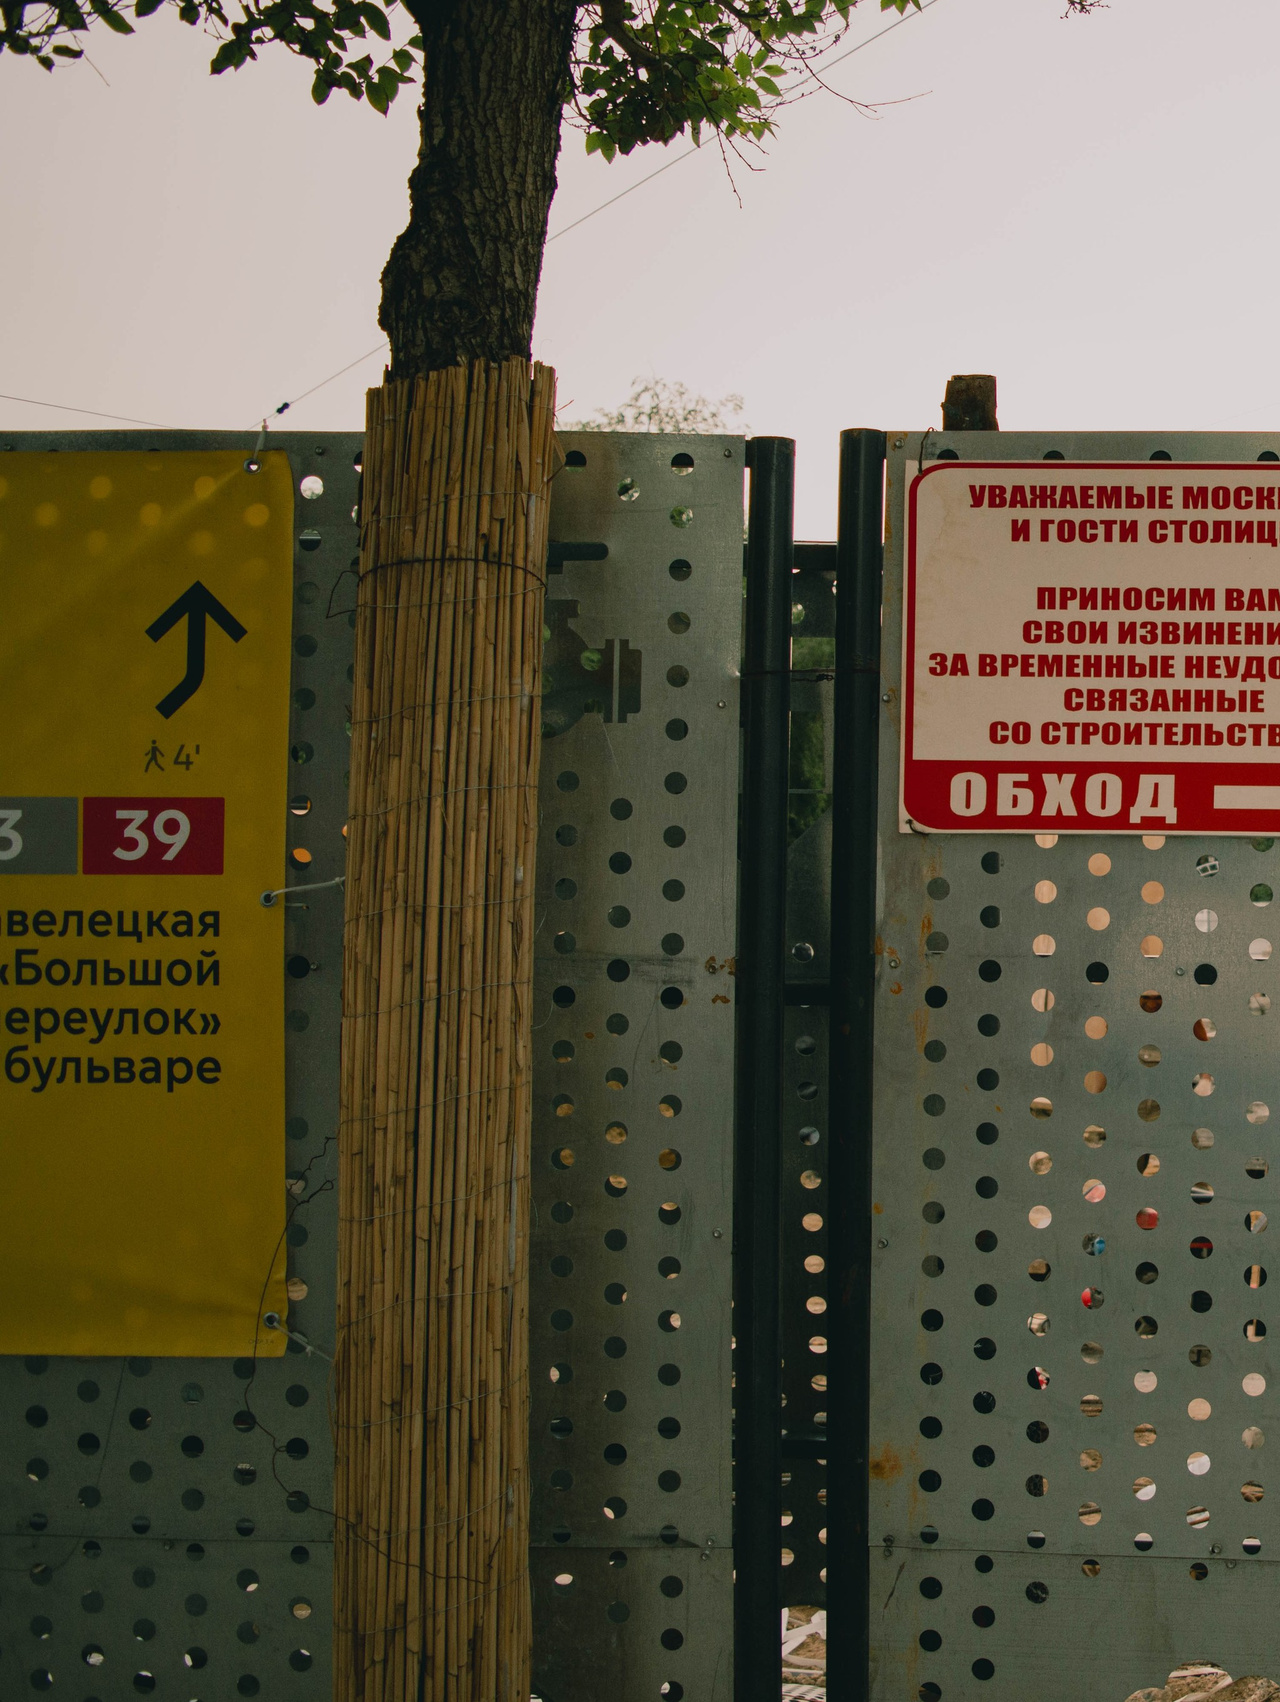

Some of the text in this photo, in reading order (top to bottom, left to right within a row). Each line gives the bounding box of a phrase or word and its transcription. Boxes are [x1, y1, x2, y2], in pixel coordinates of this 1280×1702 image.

[969, 484, 1174, 510] УВАЖАЕМЫЕ
[1011, 519, 1031, 542] И
[1040, 519, 1139, 544] ГОСТИ
[1036, 586, 1217, 612] ПРИНОСИМ
[1022, 619, 1109, 645] СВОИ
[928, 652, 970, 677] ЗА
[978, 652, 1176, 679] ВРЕМЕННЫЕ
[1063, 687, 1266, 714] СВЯЗАННЫЕ
[988, 720, 1032, 745] СО
[949, 771, 1178, 824] ОБХОД
[0, 810, 191, 862] 3 39
[0, 909, 221, 943] велецкая
[0, 1007, 222, 1044] ереулок»
[4, 1044, 222, 1093] бульваре
